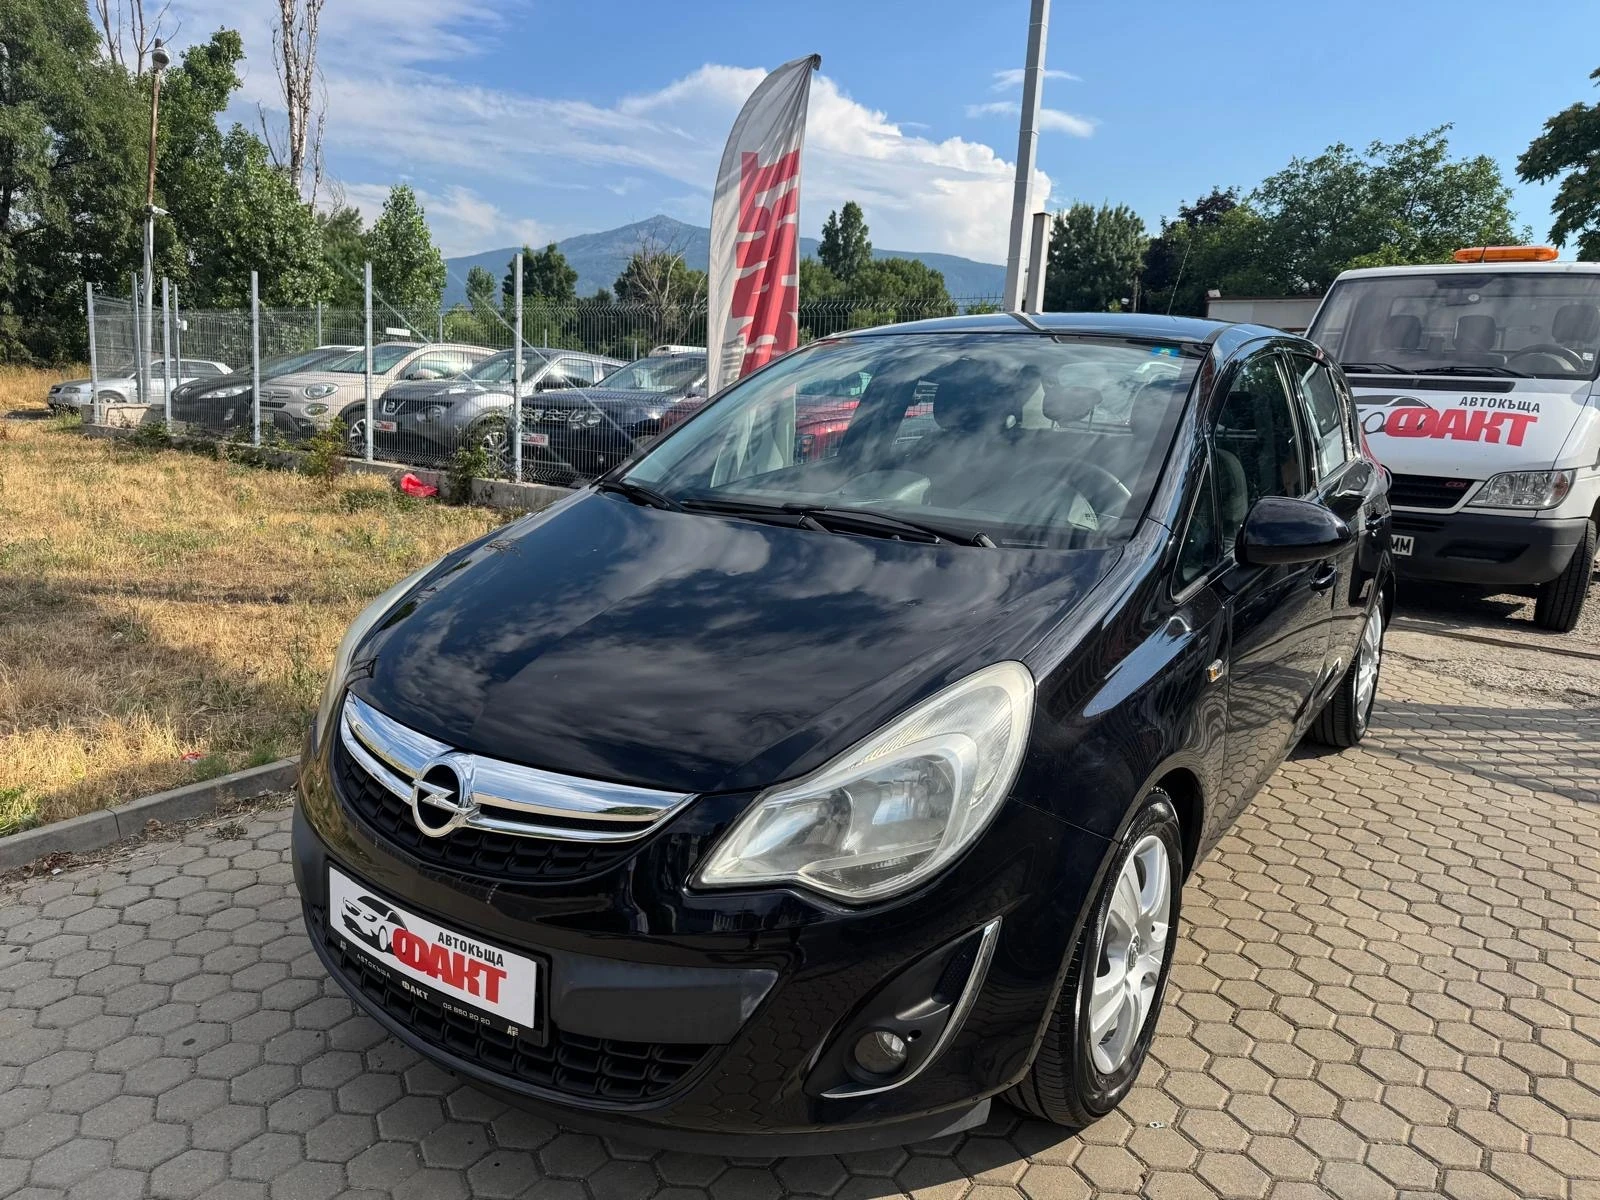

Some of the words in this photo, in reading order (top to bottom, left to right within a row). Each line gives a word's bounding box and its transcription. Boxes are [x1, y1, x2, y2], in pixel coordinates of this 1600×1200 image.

[1459, 396, 1540, 413] АВТОКЪЩА
[1385, 407, 1538, 447] ФАКТ
[437, 931, 504, 967] АВТОКЪЩА
[392, 927, 507, 1004] ФАКТ
[401, 980, 429, 1000] ФАКТ
[442, 1002, 452, 1011] 02
